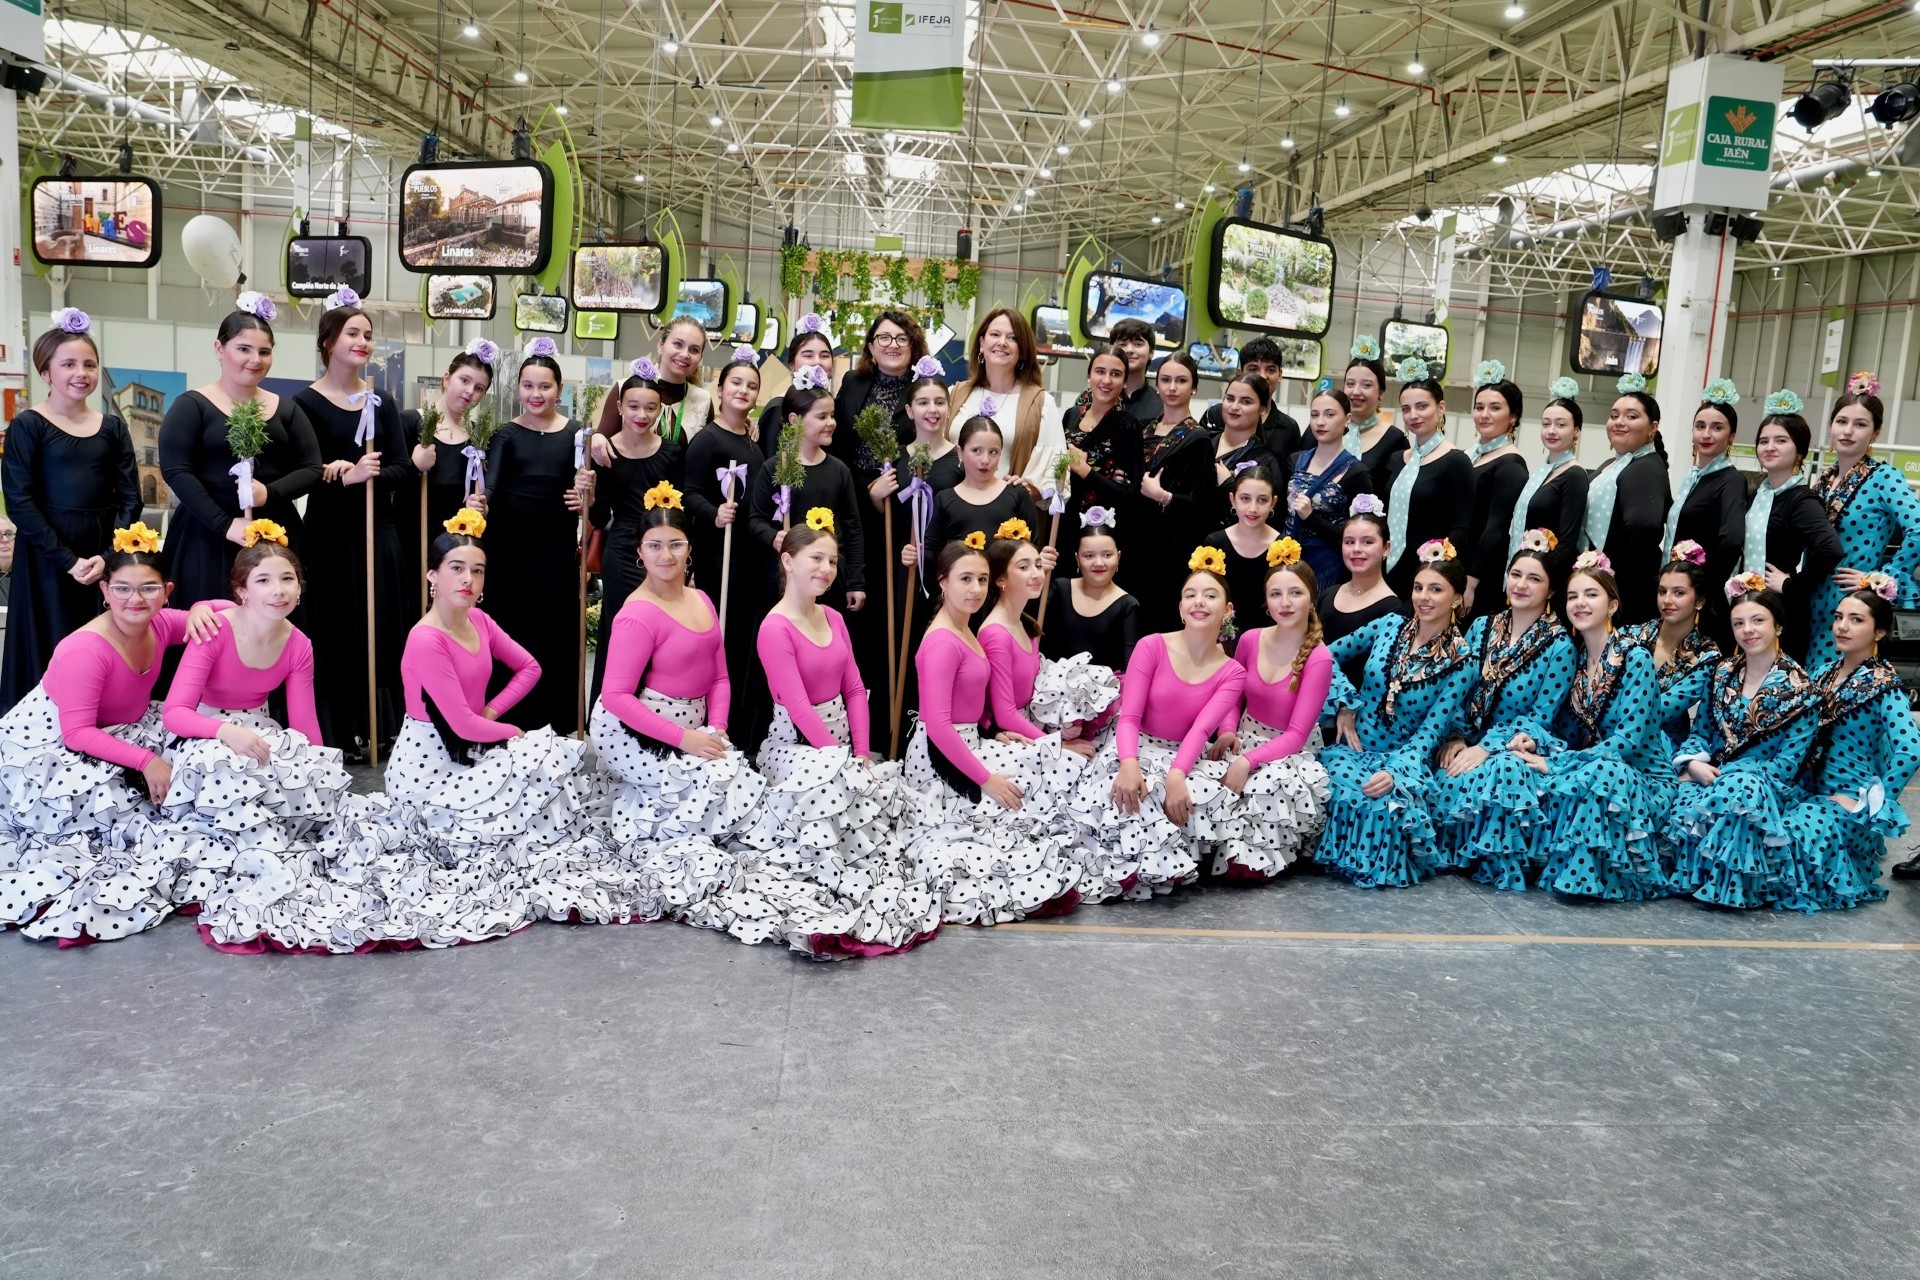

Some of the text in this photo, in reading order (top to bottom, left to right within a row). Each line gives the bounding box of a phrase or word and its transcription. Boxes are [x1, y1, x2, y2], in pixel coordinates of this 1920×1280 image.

[918, 15, 951, 24] IFEJA
[1706, 132, 1769, 149] CAJA RURAL
[1723, 147, 1750, 159] JAÉN
[88, 244, 117, 254] Linares
[441, 245, 474, 257] Linares
[314, 282, 329, 290] Norte
[330, 281, 337, 290] de
[1605, 355, 1618, 366] Jaén
[1320, 379, 1329, 391] 2
